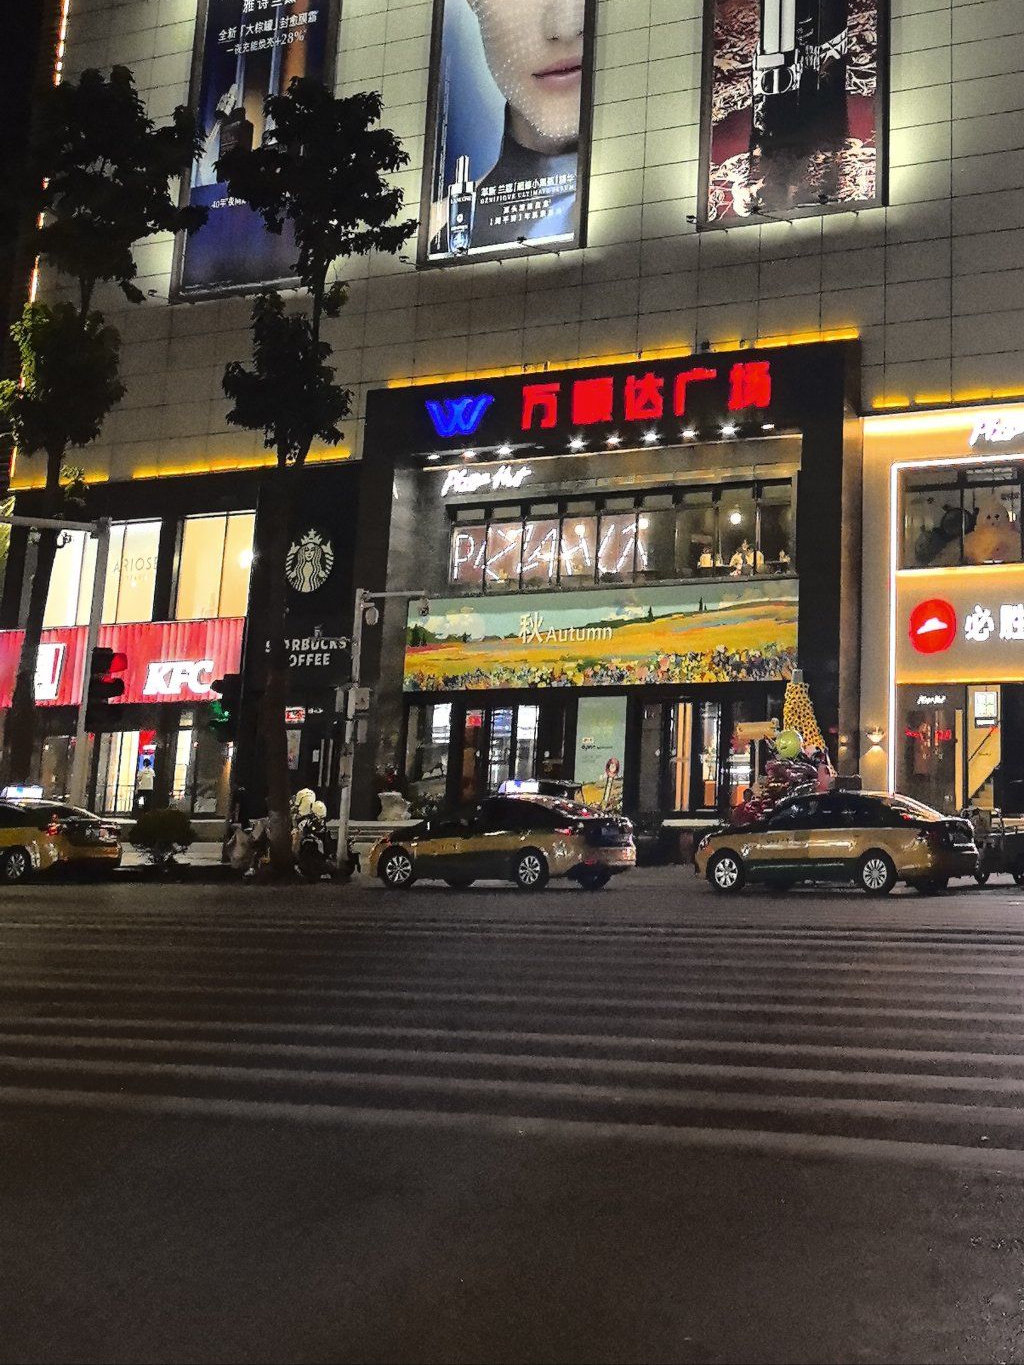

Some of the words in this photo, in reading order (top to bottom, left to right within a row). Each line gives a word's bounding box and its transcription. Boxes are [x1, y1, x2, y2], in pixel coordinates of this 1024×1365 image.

[521, 361, 772, 431] 万顺达广场
[519, 611, 544, 645] 秋
[546, 625, 614, 643] Autumn
[143, 659, 214, 695] KFC
[288, 653, 331, 667] OFFEE
